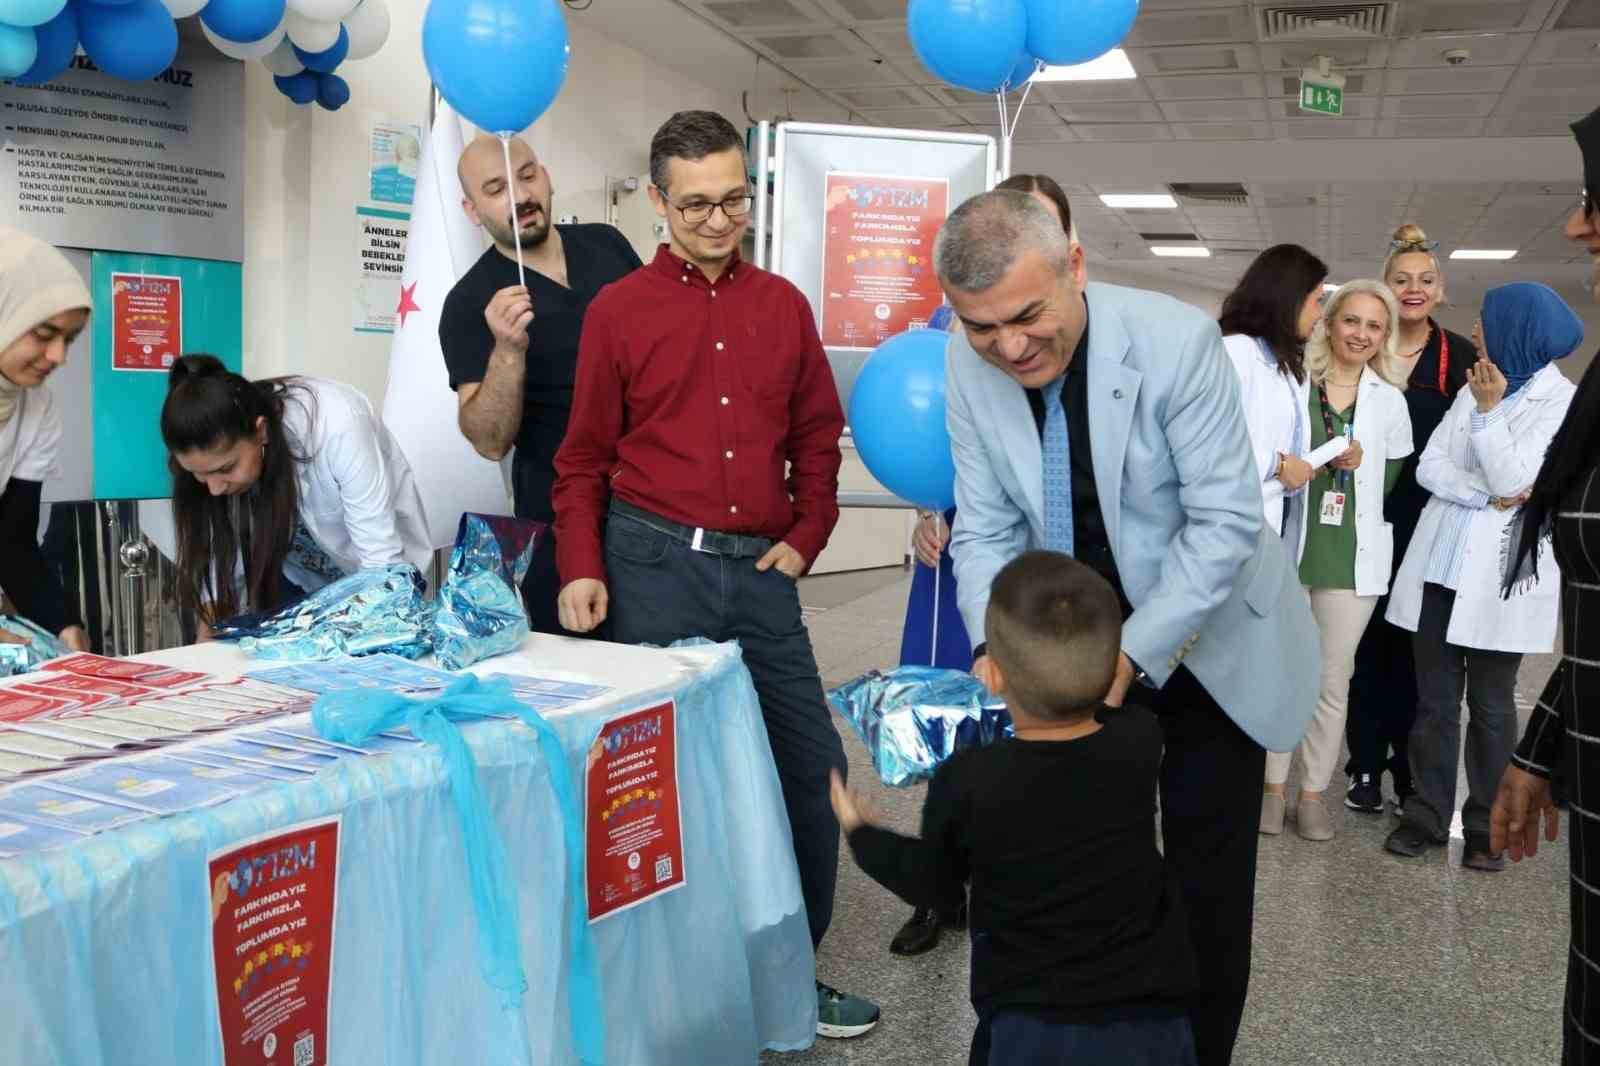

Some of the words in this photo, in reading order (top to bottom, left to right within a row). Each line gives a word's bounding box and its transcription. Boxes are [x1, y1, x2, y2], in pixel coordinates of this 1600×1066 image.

[18, 148, 45, 157] HASTA
[47, 151, 58, 159] VE
[128, 191, 149, 200] DAHA
[371, 238, 400, 249] BİLSİN
[234, 883, 306, 919] FARKINDAYIZ
[236, 900, 301, 933] FARKIMIZLA
[235, 917, 307, 956] TOPLUMDAYIZ
